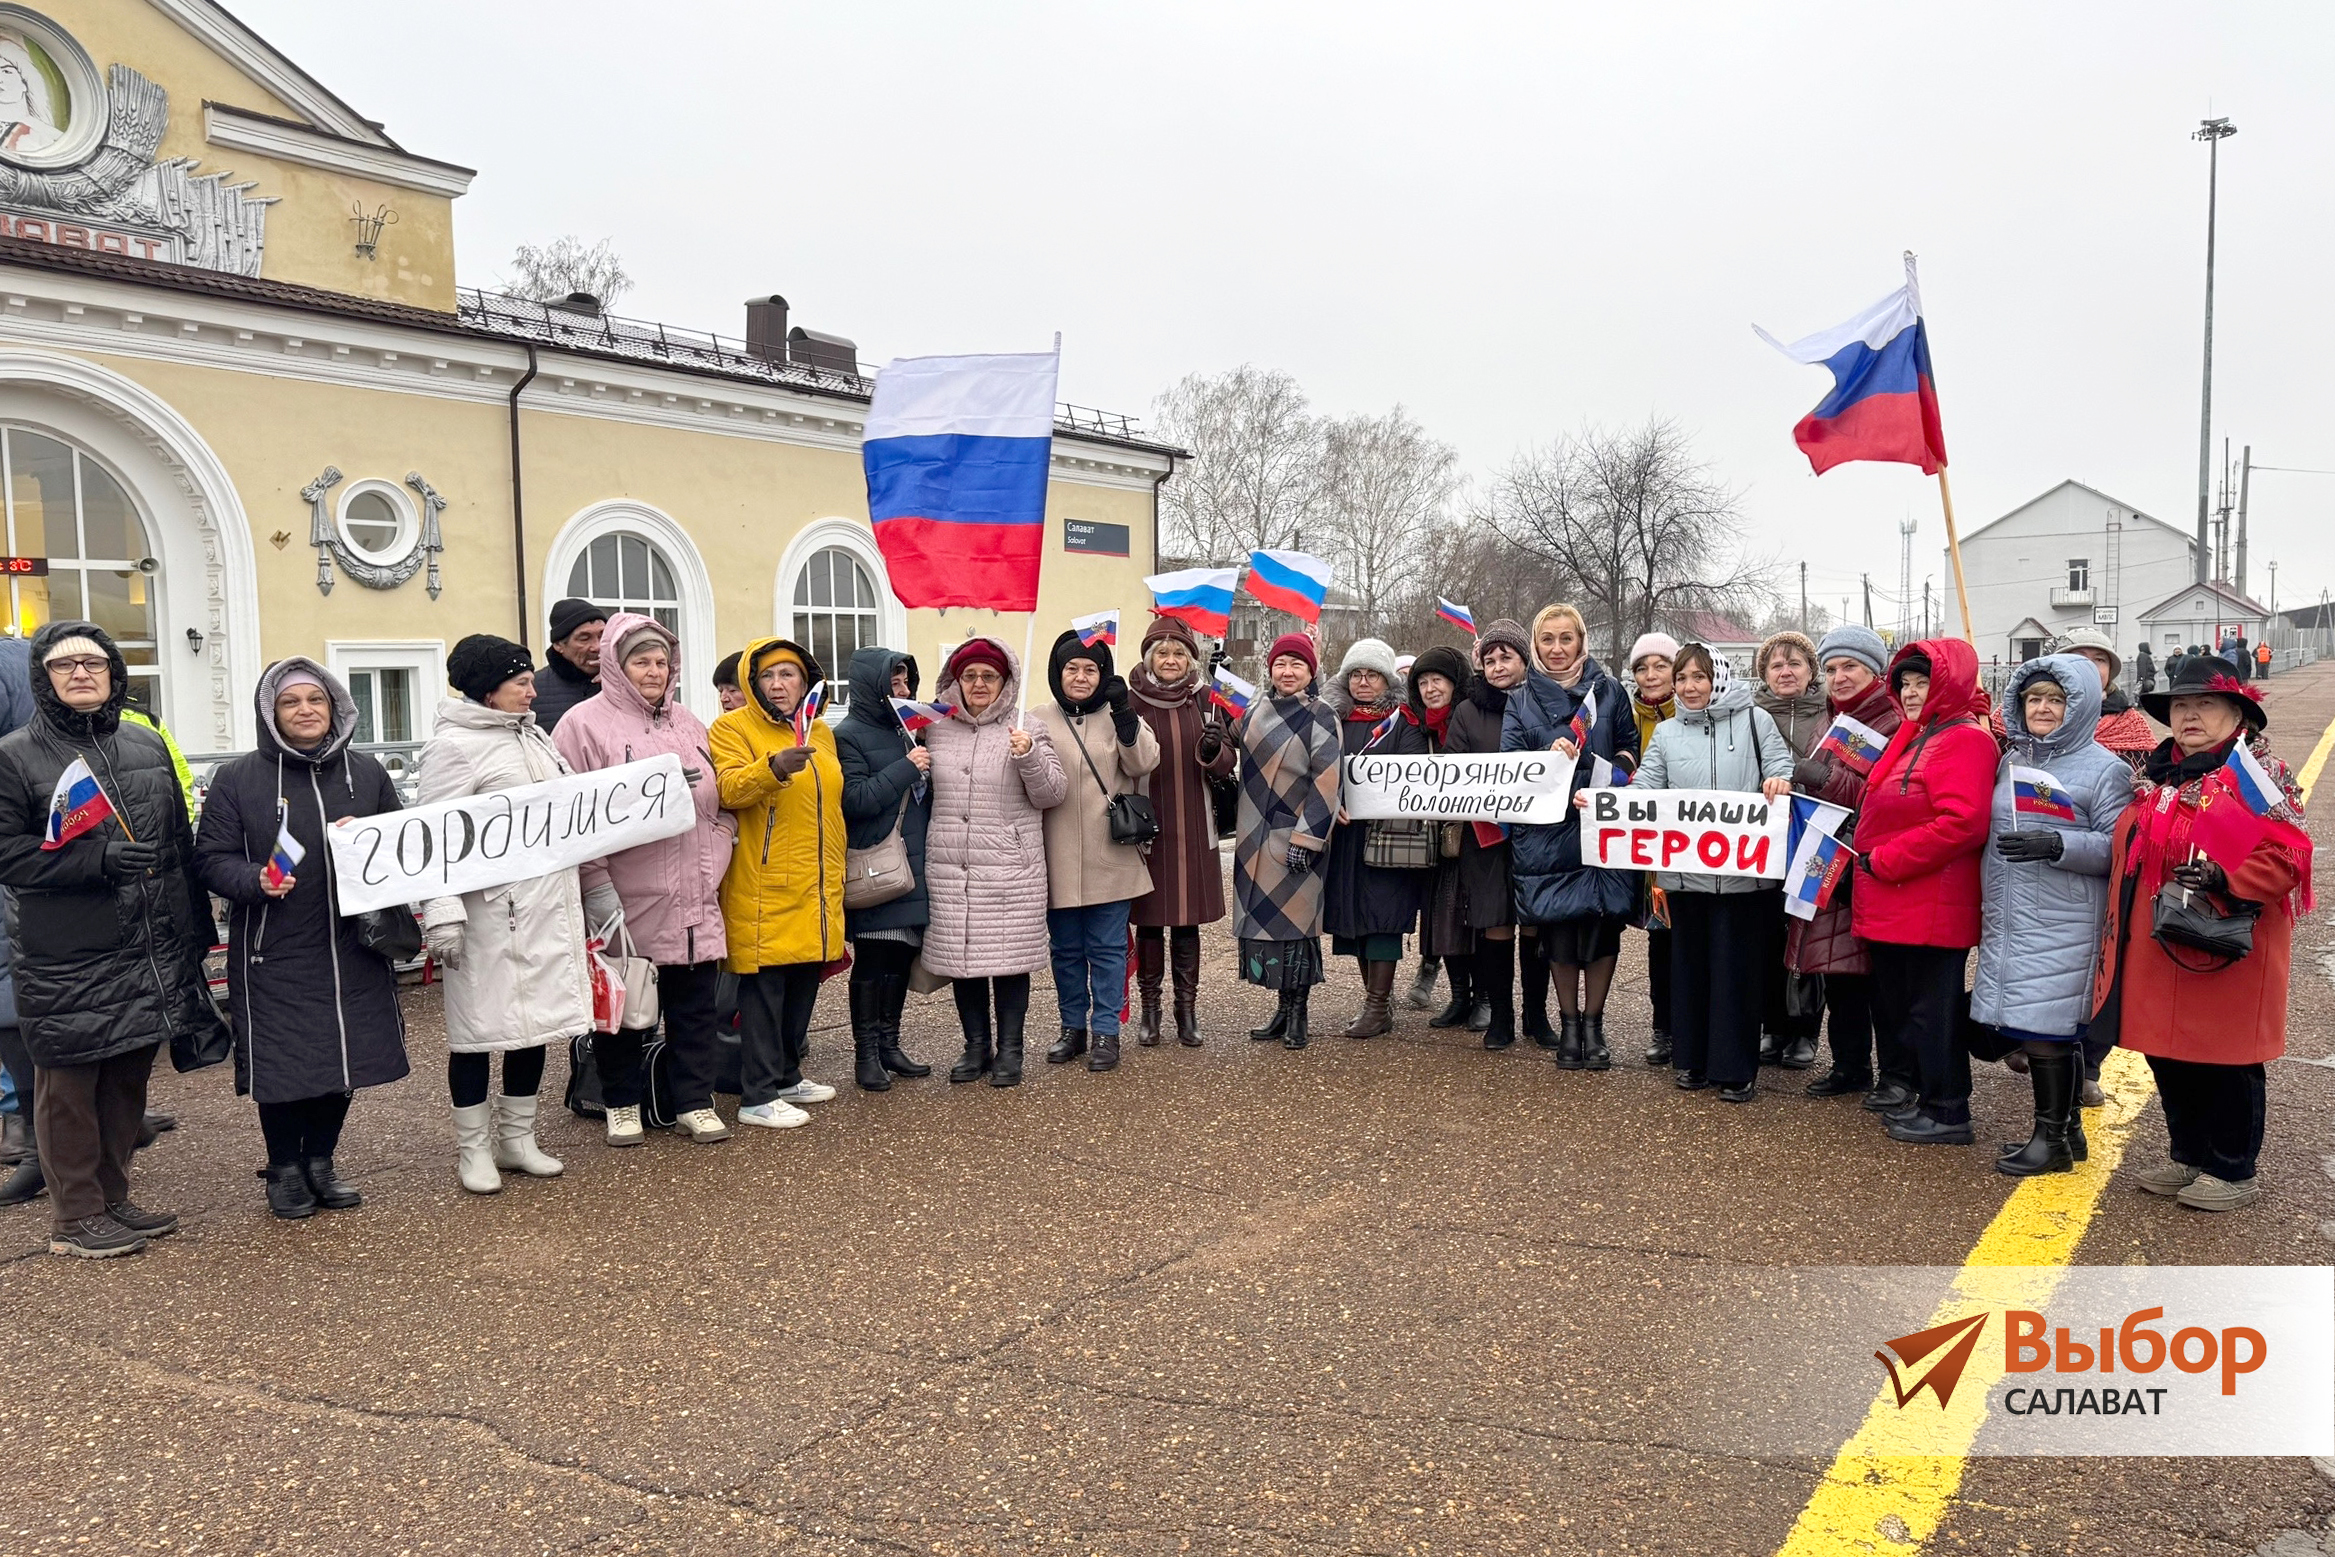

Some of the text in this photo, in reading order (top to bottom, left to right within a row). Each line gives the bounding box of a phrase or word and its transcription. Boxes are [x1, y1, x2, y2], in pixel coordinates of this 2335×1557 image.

[1067, 522, 1095, 533] Салават
[1347, 755, 1546, 793] Серебряные
[1398, 785, 1534, 819] волонтёры
[353, 772, 668, 886] гордимся
[1599, 828, 1770, 875] ГЕРОИ
